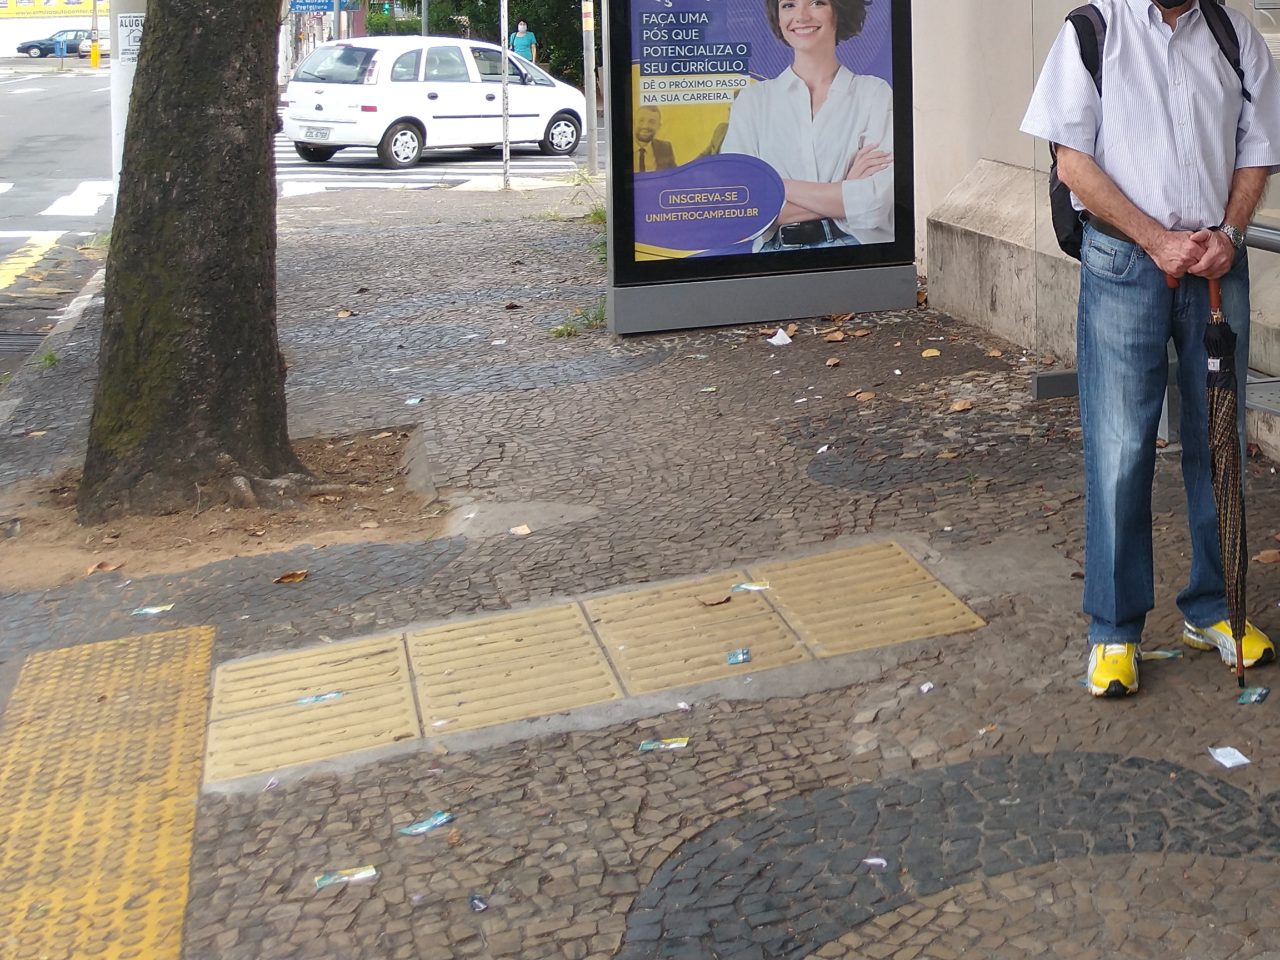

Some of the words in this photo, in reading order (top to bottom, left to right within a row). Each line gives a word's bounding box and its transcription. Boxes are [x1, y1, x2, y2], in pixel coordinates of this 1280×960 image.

[643, 13, 676, 27] FAÇA
[680, 13, 708, 23] UMA
[643, 27, 668, 40] PÓS
[672, 29, 699, 40] QUE
[643, 45, 733, 57] POTENCIALIZA
[737, 44, 747, 55] O
[644, 62, 668, 73] SEU
[672, 59, 746, 73] CURRÍCULO.
[643, 80, 656, 89] DÊ
[669, 78, 713, 88] PRÓXIMO
[716, 79, 747, 87] PASSO
[643, 94, 658, 102] NA
[683, 92, 731, 101] CARREIRA.
[668, 192, 738, 204] INSCREVA-SE
[646, 208, 758, 222] UNIMETROCAMP.EDU.BR
